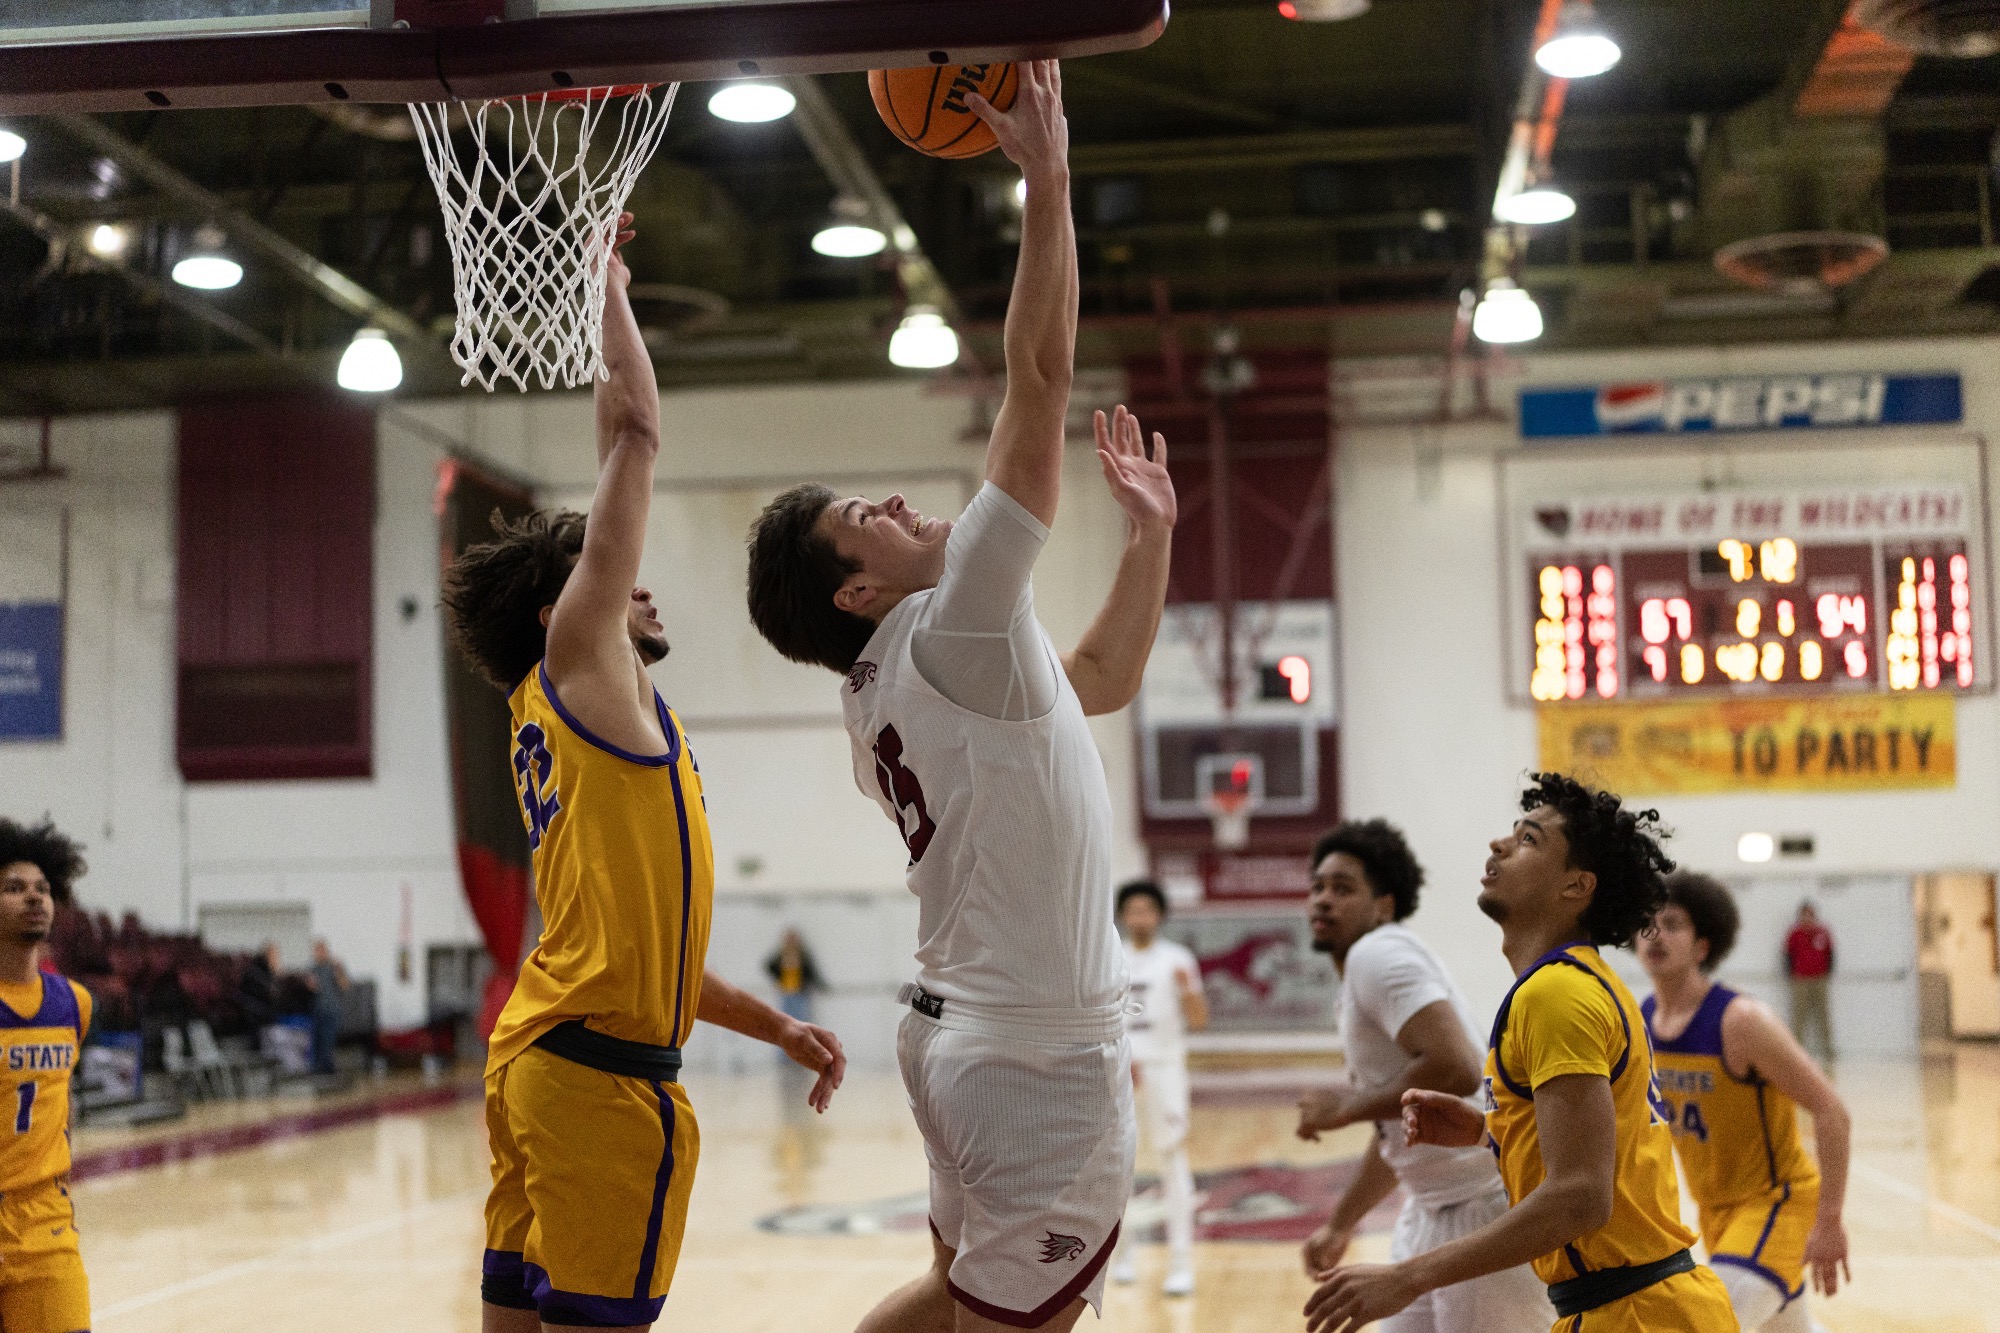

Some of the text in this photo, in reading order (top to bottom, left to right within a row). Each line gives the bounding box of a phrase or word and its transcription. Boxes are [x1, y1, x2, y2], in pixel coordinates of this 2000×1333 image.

[1663, 376, 1886, 431] PEPSI
[1577, 505, 1665, 534] HOME
[1678, 503, 1716, 532] OF
[1732, 500, 1785, 530] THE
[1278, 655, 1311, 704] 7
[1731, 728, 1779, 777] TO
[1794, 725, 1934, 773] PARTY
[15, 1080, 37, 1134] 1
